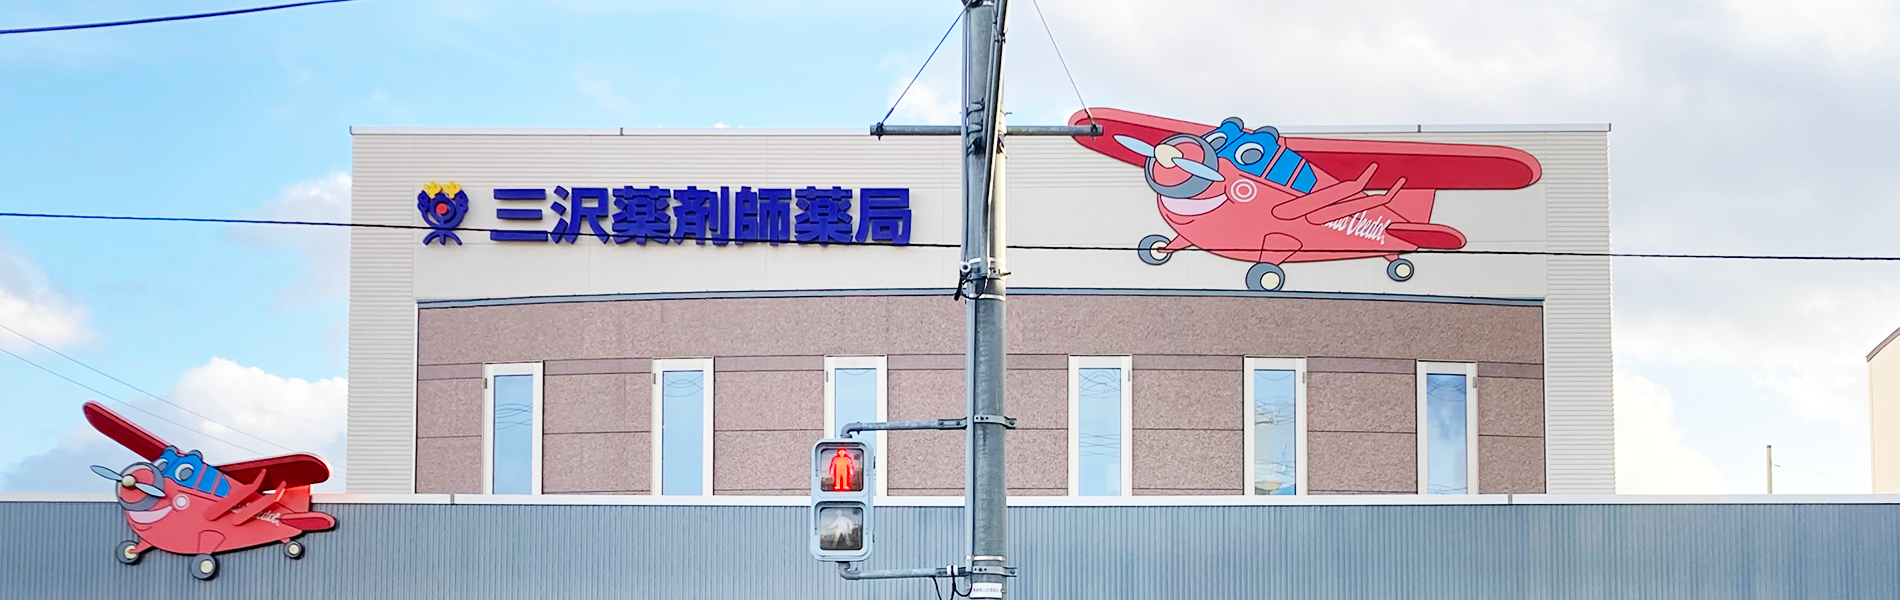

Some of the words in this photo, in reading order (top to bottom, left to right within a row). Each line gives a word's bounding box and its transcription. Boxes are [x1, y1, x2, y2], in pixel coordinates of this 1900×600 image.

[490, 185, 912, 246] 三沢薬剤師薬局
